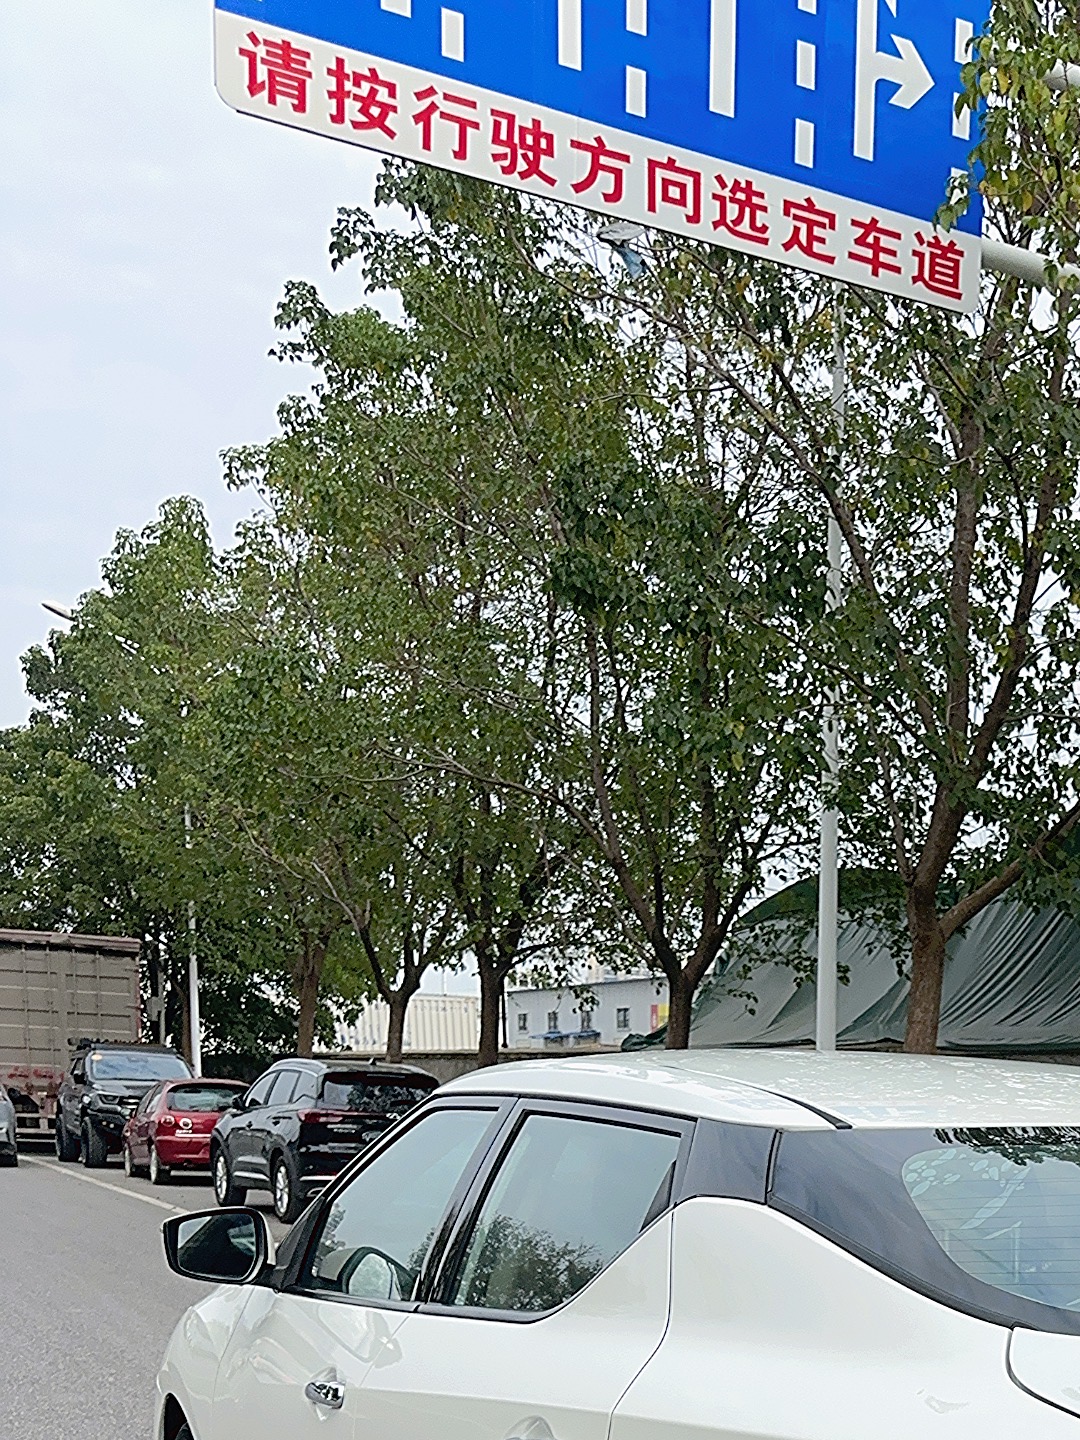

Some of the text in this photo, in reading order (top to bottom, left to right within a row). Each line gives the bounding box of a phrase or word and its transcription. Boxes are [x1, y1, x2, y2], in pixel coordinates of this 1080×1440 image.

[239, 31, 965, 301] 请按行驶方向选定车道
